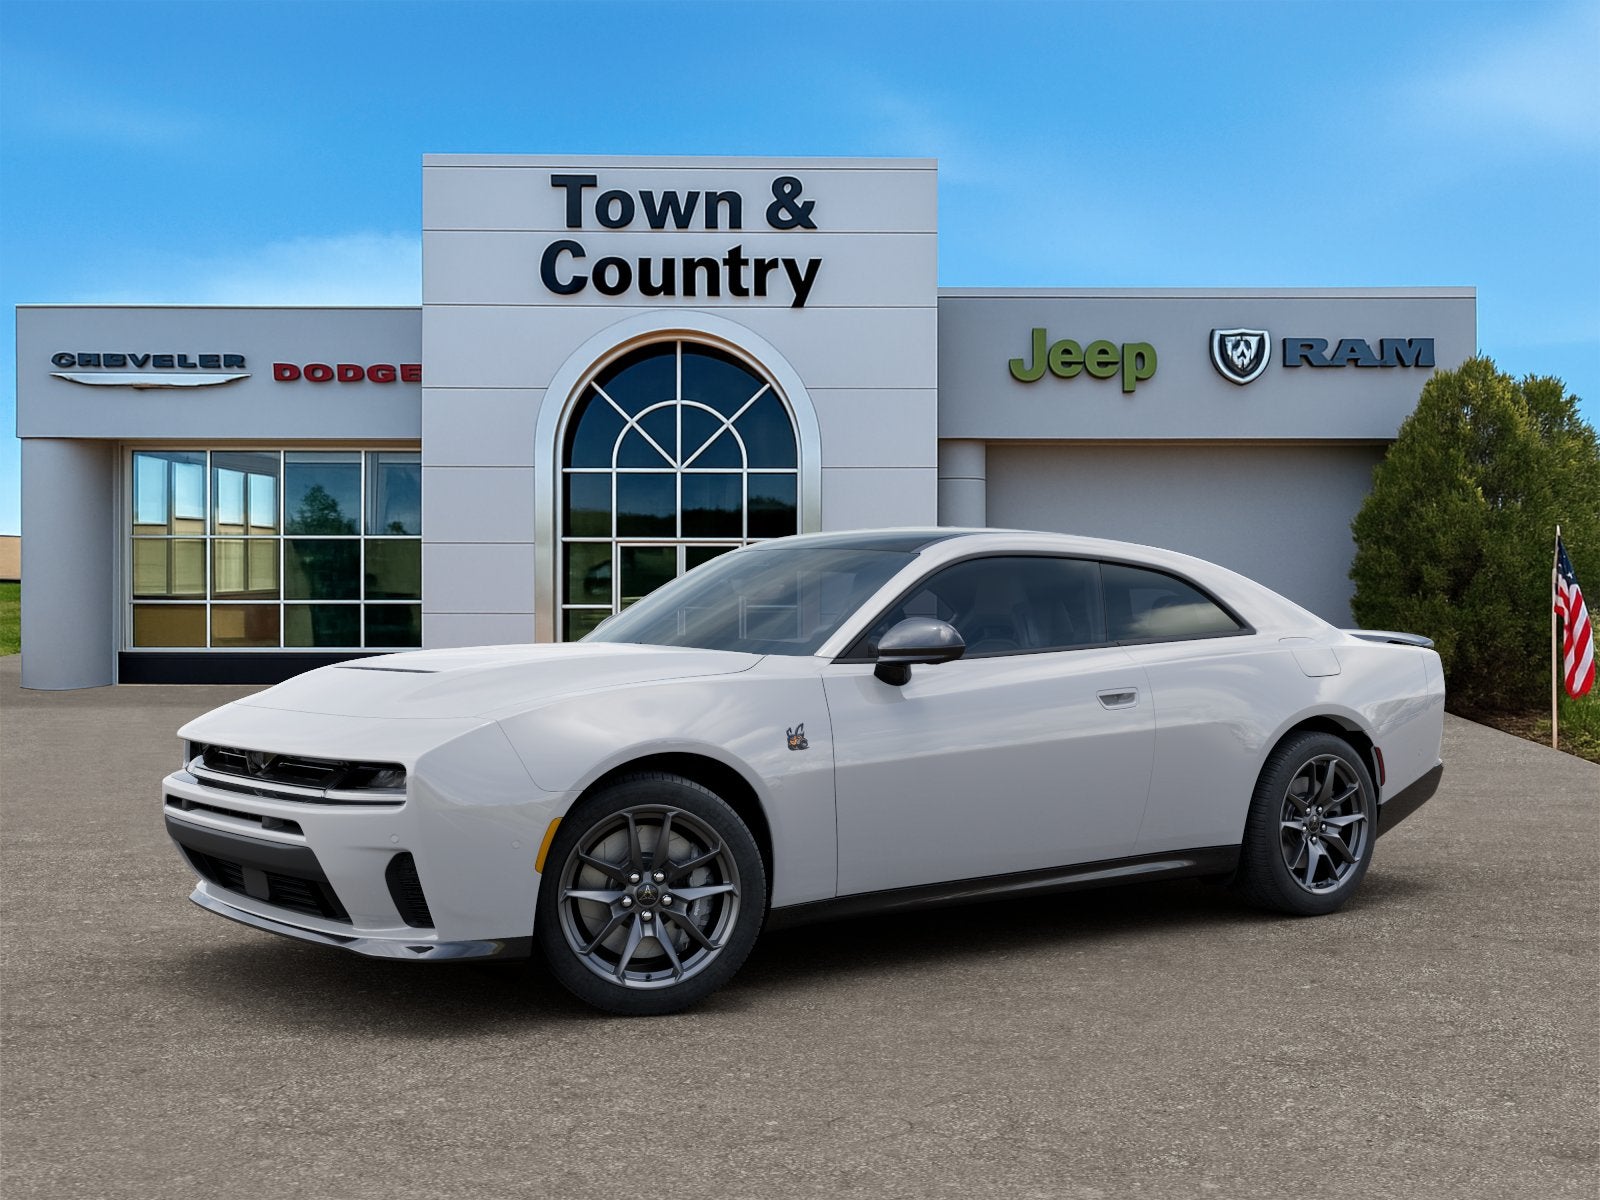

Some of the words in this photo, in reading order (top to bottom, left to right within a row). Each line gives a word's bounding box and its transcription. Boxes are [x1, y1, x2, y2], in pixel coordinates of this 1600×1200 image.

[550, 174, 742, 229] Town
[765, 176, 818, 230] &
[540, 239, 822, 308] Country
[273, 363, 422, 383] DODGE
[1009, 327, 1158, 392] Jeep
[1282, 337, 1436, 368] RAM
